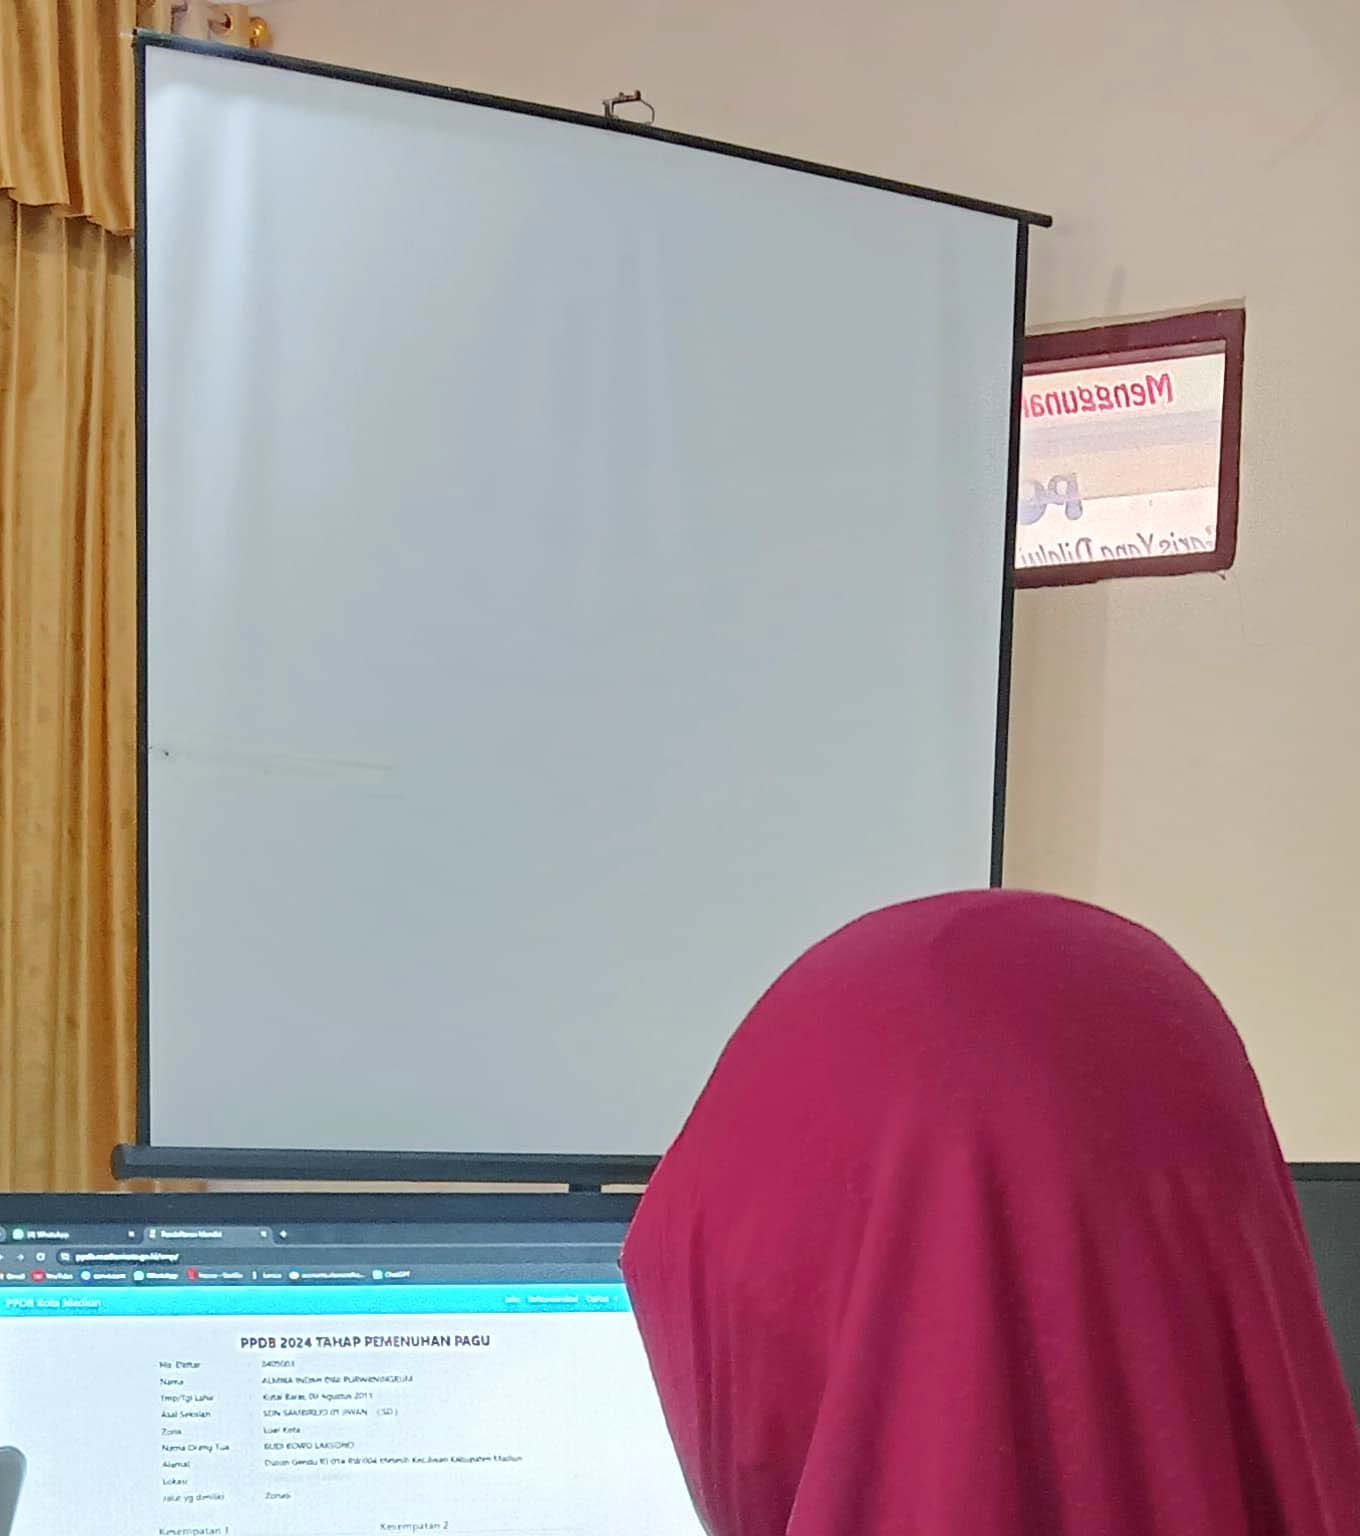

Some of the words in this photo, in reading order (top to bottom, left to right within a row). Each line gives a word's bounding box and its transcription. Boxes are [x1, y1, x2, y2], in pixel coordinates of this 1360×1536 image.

[241, 1337, 276, 1349] PPDB
[280, 1336, 312, 1348] 2024
[316, 1336, 361, 1348] TAHAP
[365, 1335, 451, 1348] PEMENUHAN
[455, 1335, 491, 1346] PAGU
[380, 1522, 441, 1533] Kesempatan
